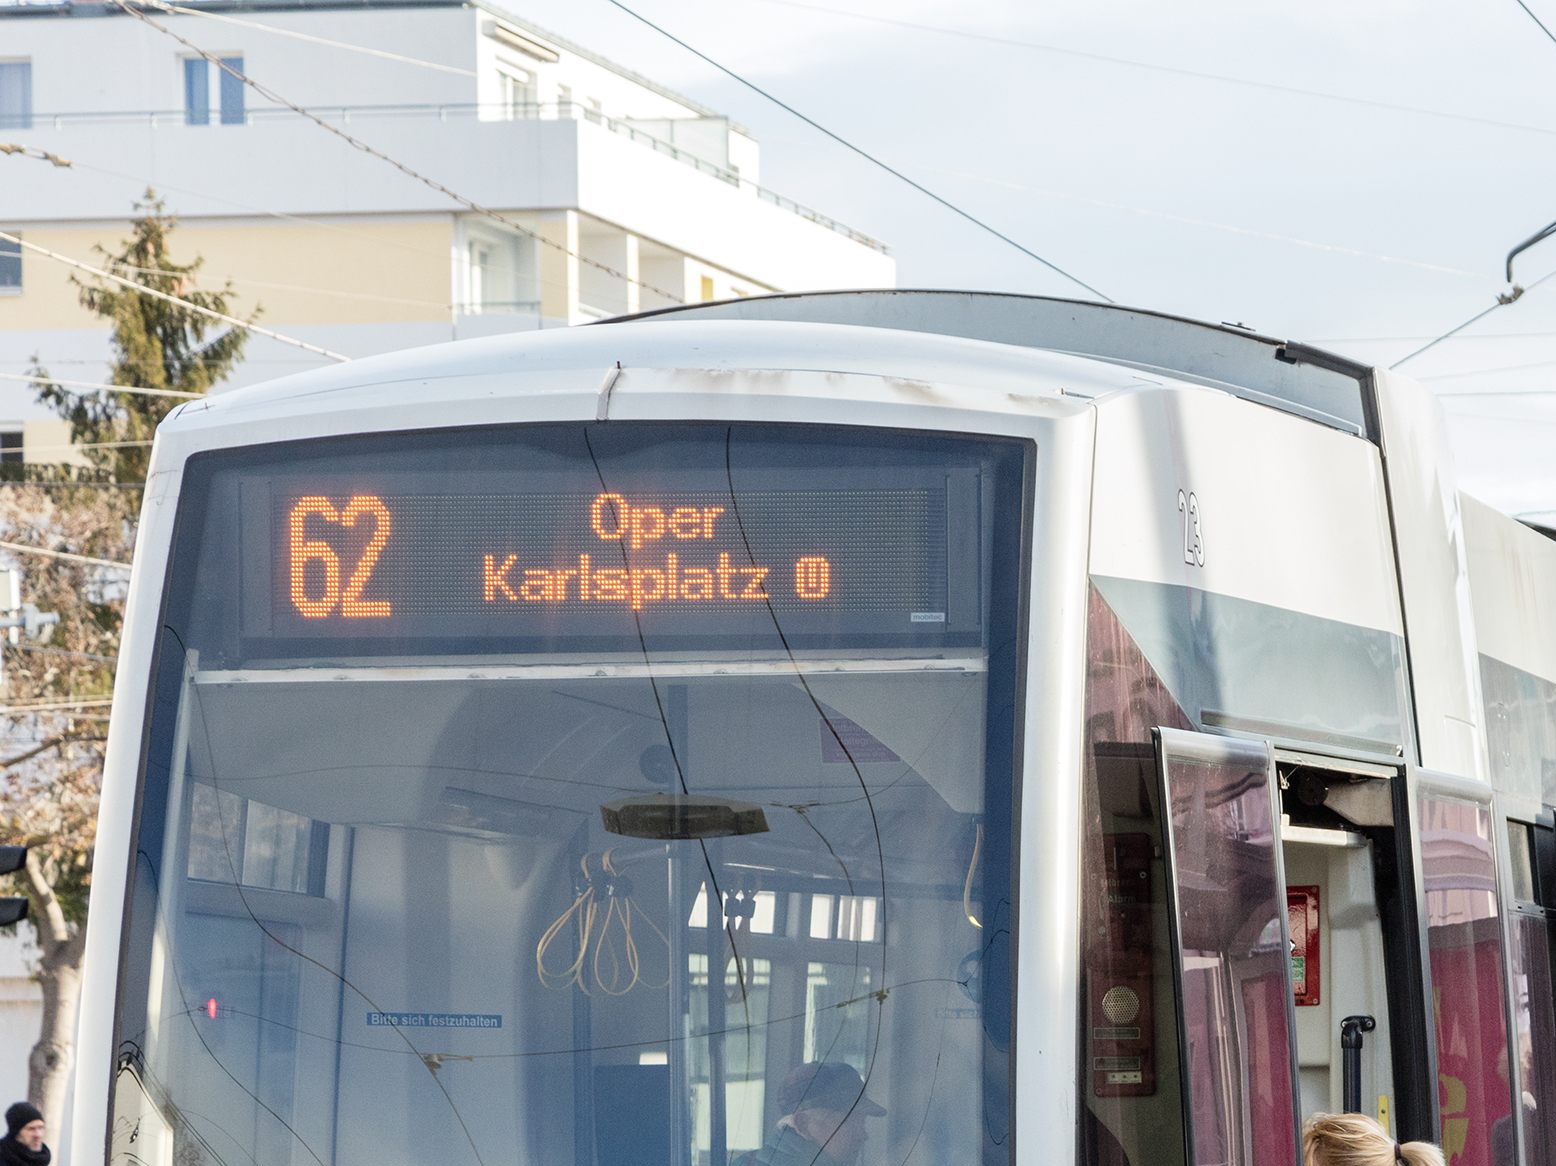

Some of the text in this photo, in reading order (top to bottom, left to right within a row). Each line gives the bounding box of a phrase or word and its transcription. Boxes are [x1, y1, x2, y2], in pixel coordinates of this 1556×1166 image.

[591, 493, 726, 549] Oper
[1178, 488, 1205, 568] 23
[290, 495, 391, 618] 62
[484, 552, 769, 610] Karlsplatz
[371, 1014, 498, 1027] Bitte sich festzuhalten
